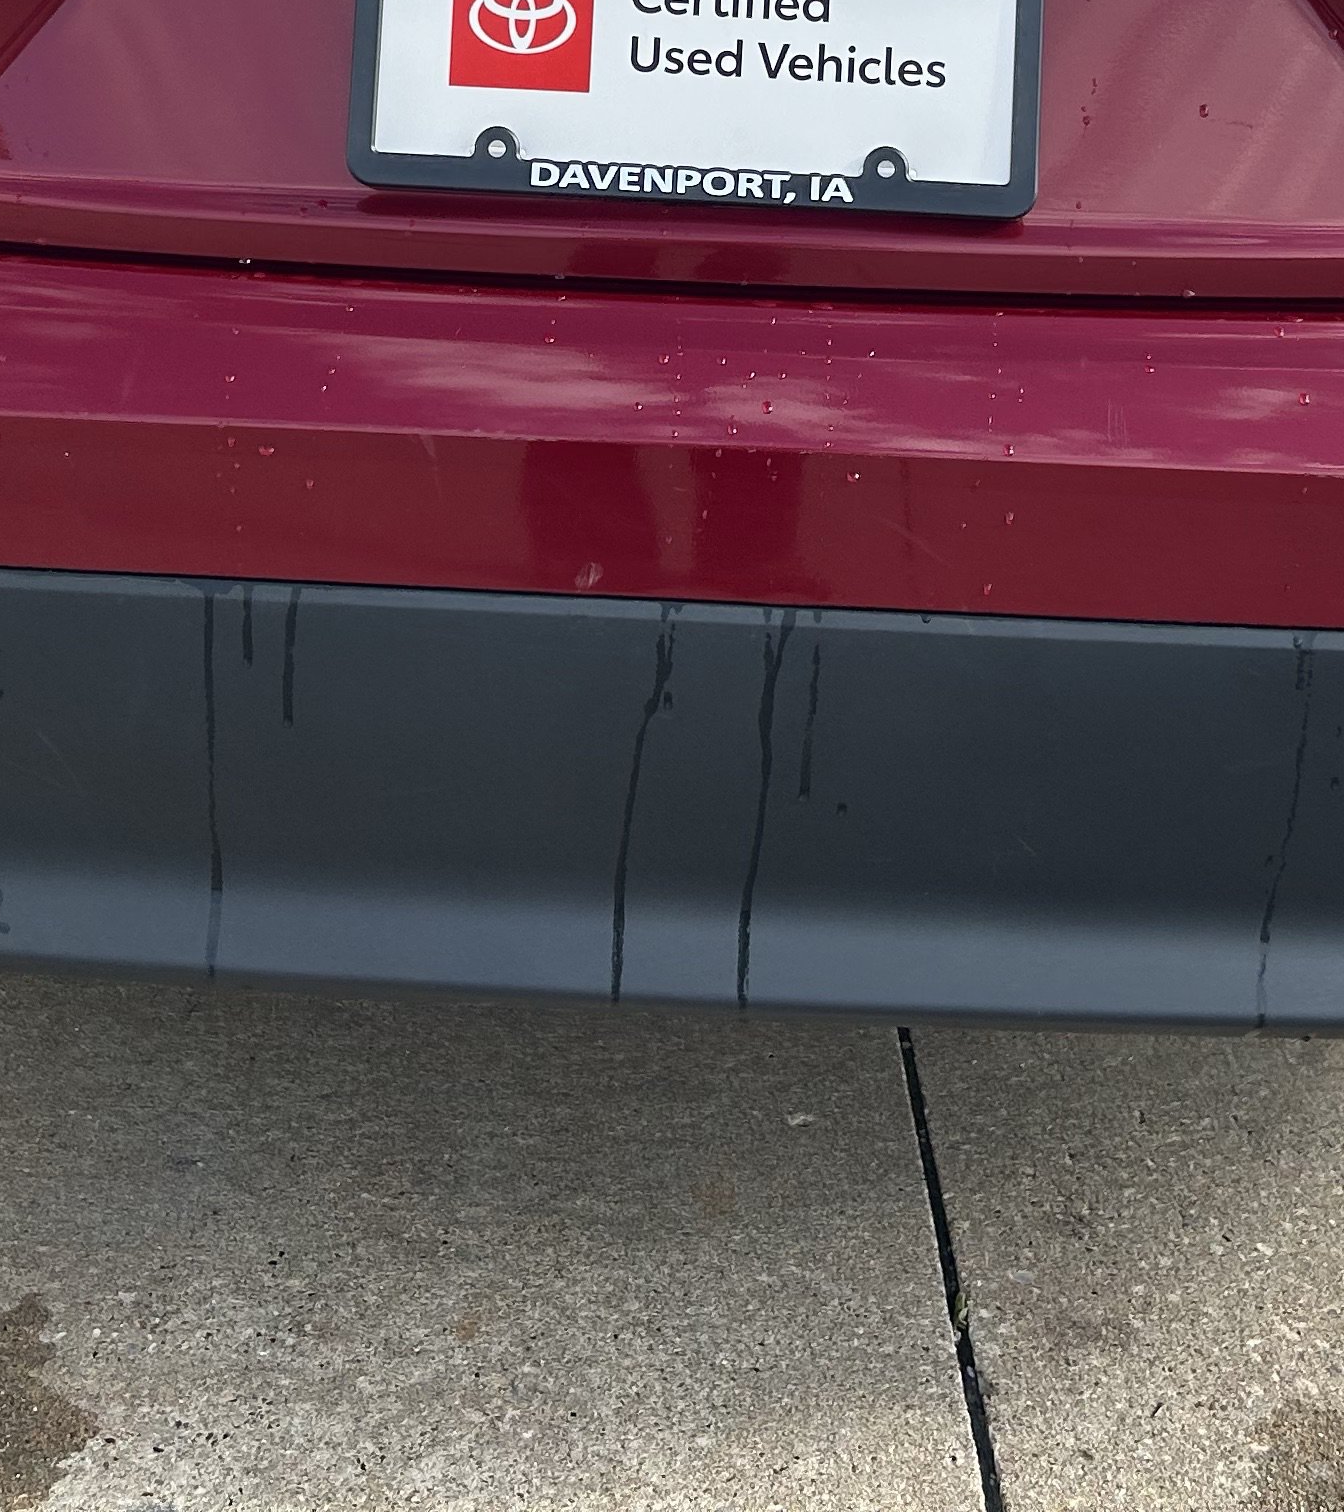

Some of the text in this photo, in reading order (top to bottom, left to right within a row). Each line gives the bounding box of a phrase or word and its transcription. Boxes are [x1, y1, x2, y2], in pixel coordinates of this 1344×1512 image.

[629, 35, 947, 89] Used Vehicles
[529, 161, 854, 204] DAVENPORT, IA
